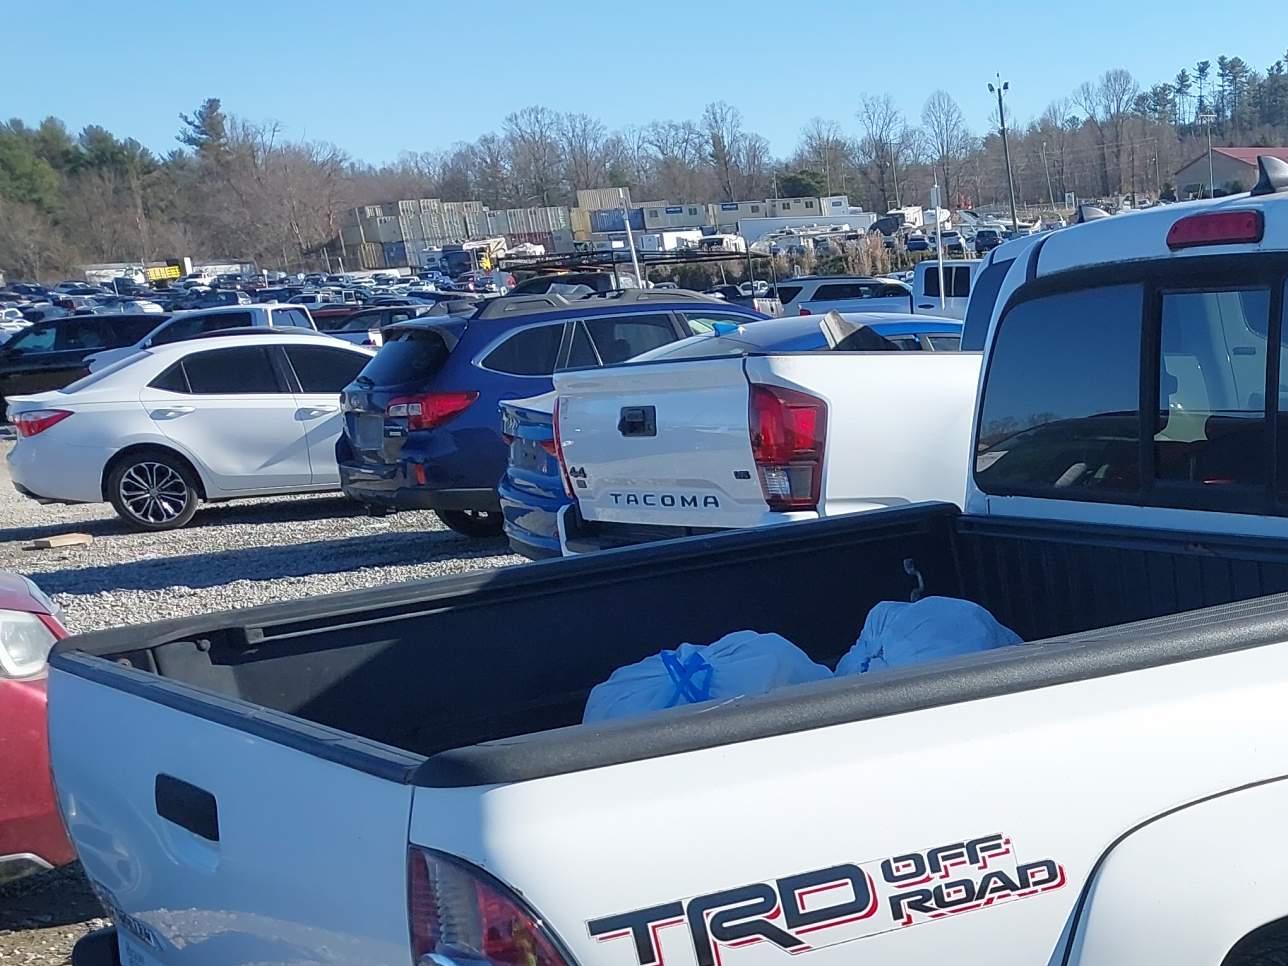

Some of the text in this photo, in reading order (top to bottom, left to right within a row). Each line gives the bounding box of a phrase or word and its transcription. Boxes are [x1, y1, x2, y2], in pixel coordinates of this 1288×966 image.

[610, 493, 720, 508] TACOMA
[880, 832, 1011, 888] OFF
[890, 858, 1067, 927] ROAD
